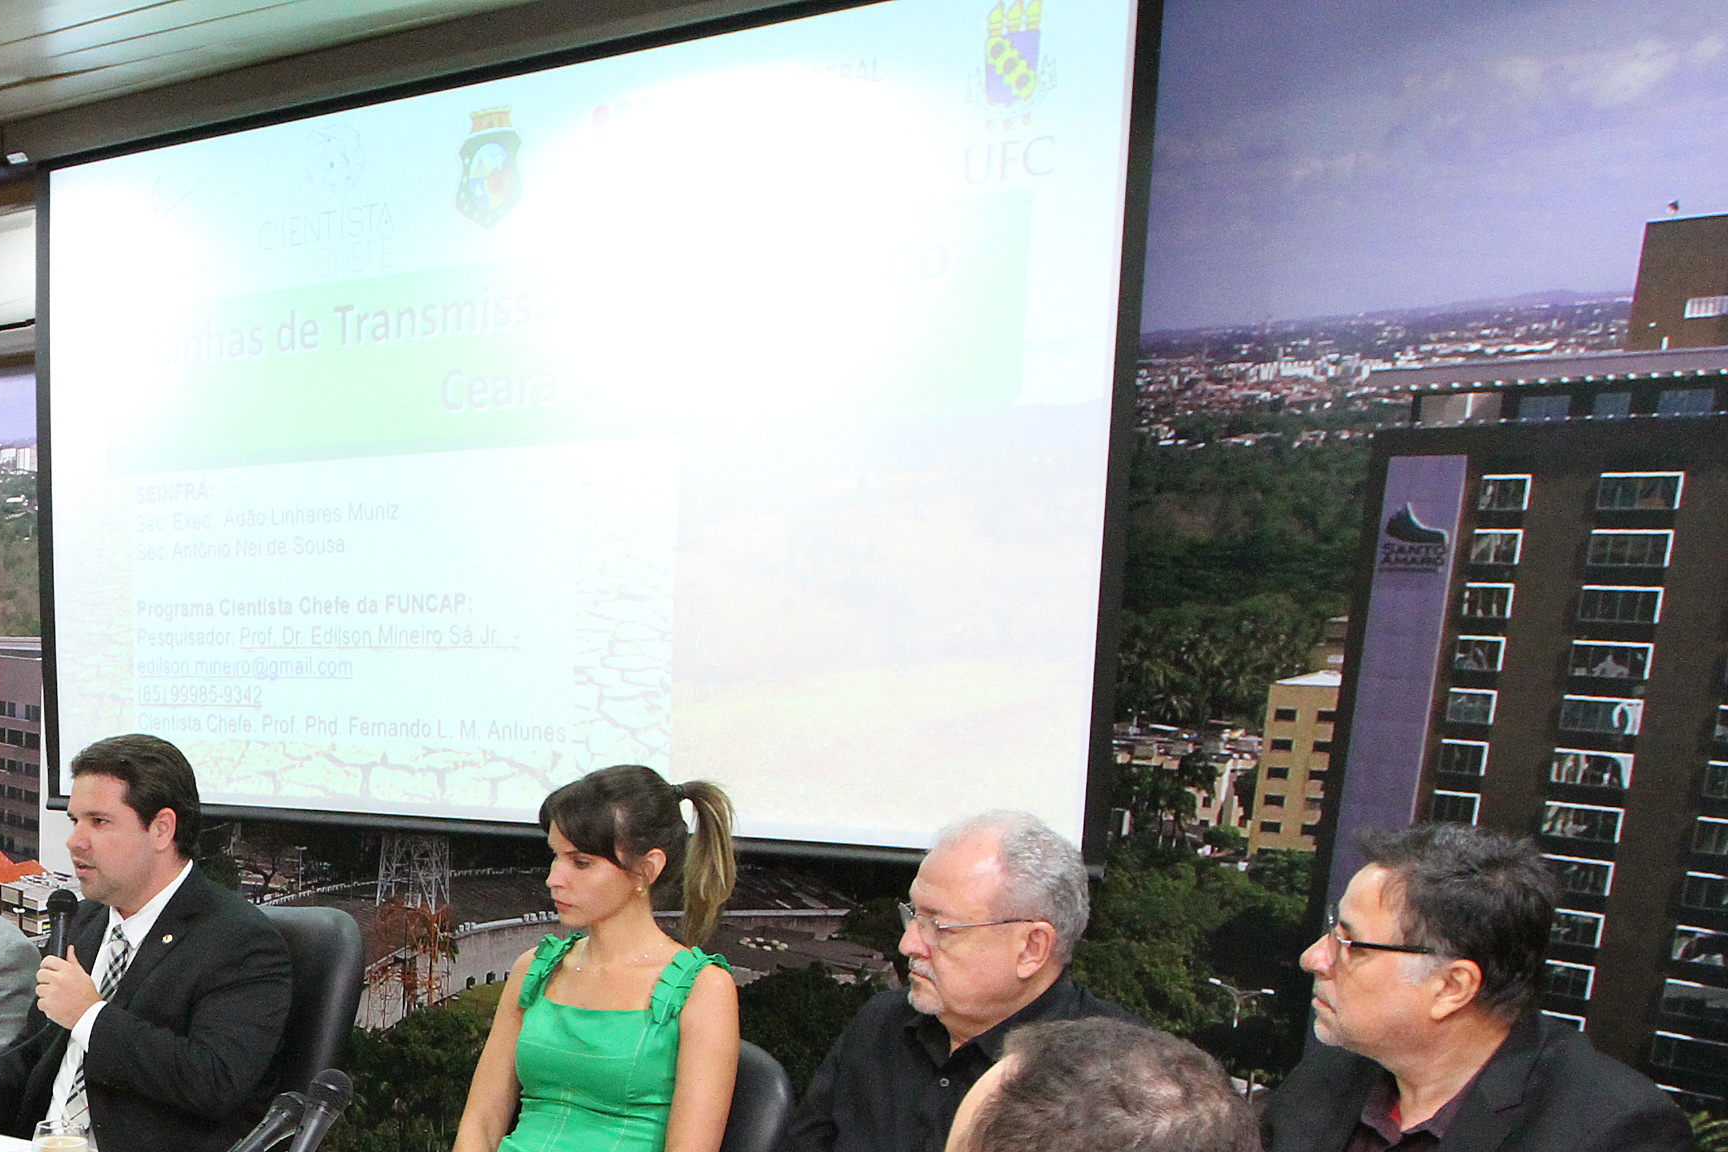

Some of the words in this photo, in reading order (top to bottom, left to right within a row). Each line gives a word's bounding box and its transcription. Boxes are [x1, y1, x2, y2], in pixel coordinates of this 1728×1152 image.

[964, 135, 1055, 185] UFC
[257, 201, 395, 251] CIENTISTA
[313, 236, 394, 278] CHEFE
[275, 308, 320, 353] de
[332, 275, 556, 347] Transmissã
[135, 481, 214, 505] SEINFRA:
[224, 508, 266, 529] Adão
[271, 505, 343, 527] Linhares
[348, 501, 400, 522] Muniz
[172, 539, 231, 560] Antônio
[235, 538, 262, 558] Nei
[267, 537, 287, 557] de
[292, 535, 346, 556] Sousa
[136, 599, 214, 622] Programa
[219, 597, 293, 617] Cientista
[299, 596, 350, 616] Chefe
[356, 595, 378, 615] da
[385, 592, 473, 614] FUNCAP:
[136, 627, 235, 651] Pesquisador:
[239, 626, 277, 648] Prof.
[282, 625, 304, 646] Dr.
[311, 625, 372, 646] Edilson
[378, 624, 443, 646] Mineiro
[449, 623, 473, 645] Sá
[479, 624, 501, 645] Jr.
[136, 656, 354, 682] edilson.mineiro@gmail.com
[138, 684, 167, 704] (85)
[170, 684, 263, 705] 99985-9342
[137, 712, 202, 733] Cientista
[261, 713, 300, 735] Prof.
[305, 714, 343, 736] Phd.
[348, 716, 432, 739] Fernando
[437, 718, 453, 739] L.
[459, 719, 481, 740] M.
[487, 719, 567, 743] Antunes
